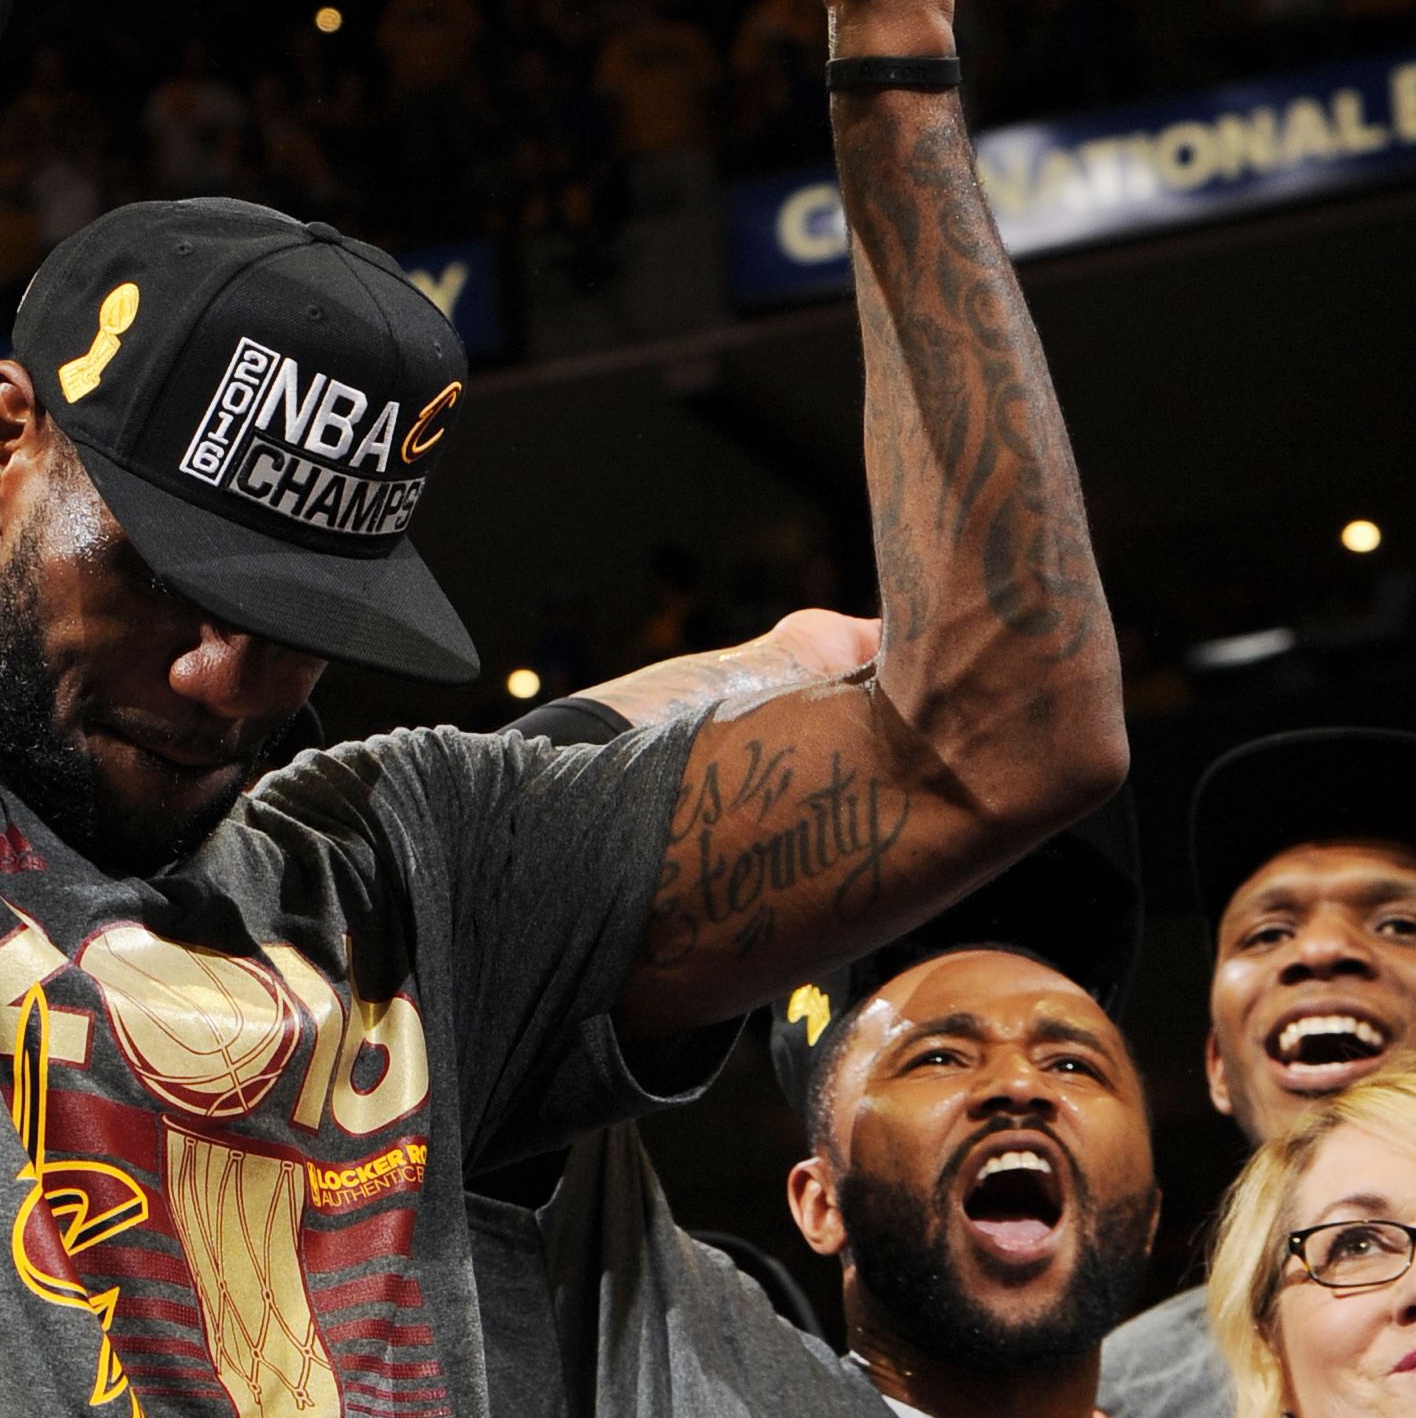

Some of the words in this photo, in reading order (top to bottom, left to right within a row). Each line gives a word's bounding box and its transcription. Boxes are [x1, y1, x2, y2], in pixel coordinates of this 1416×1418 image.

[972, 86, 1387, 217] NATIONAL
[191, 349, 269, 474] 2016
[253, 357, 401, 473] NBA
[237, 442, 422, 532] CHAMPS
[317, 1149, 407, 1190] LOCKER
[406, 1144, 428, 1165] RO
[322, 1166, 417, 1207] AUTHENTIC
